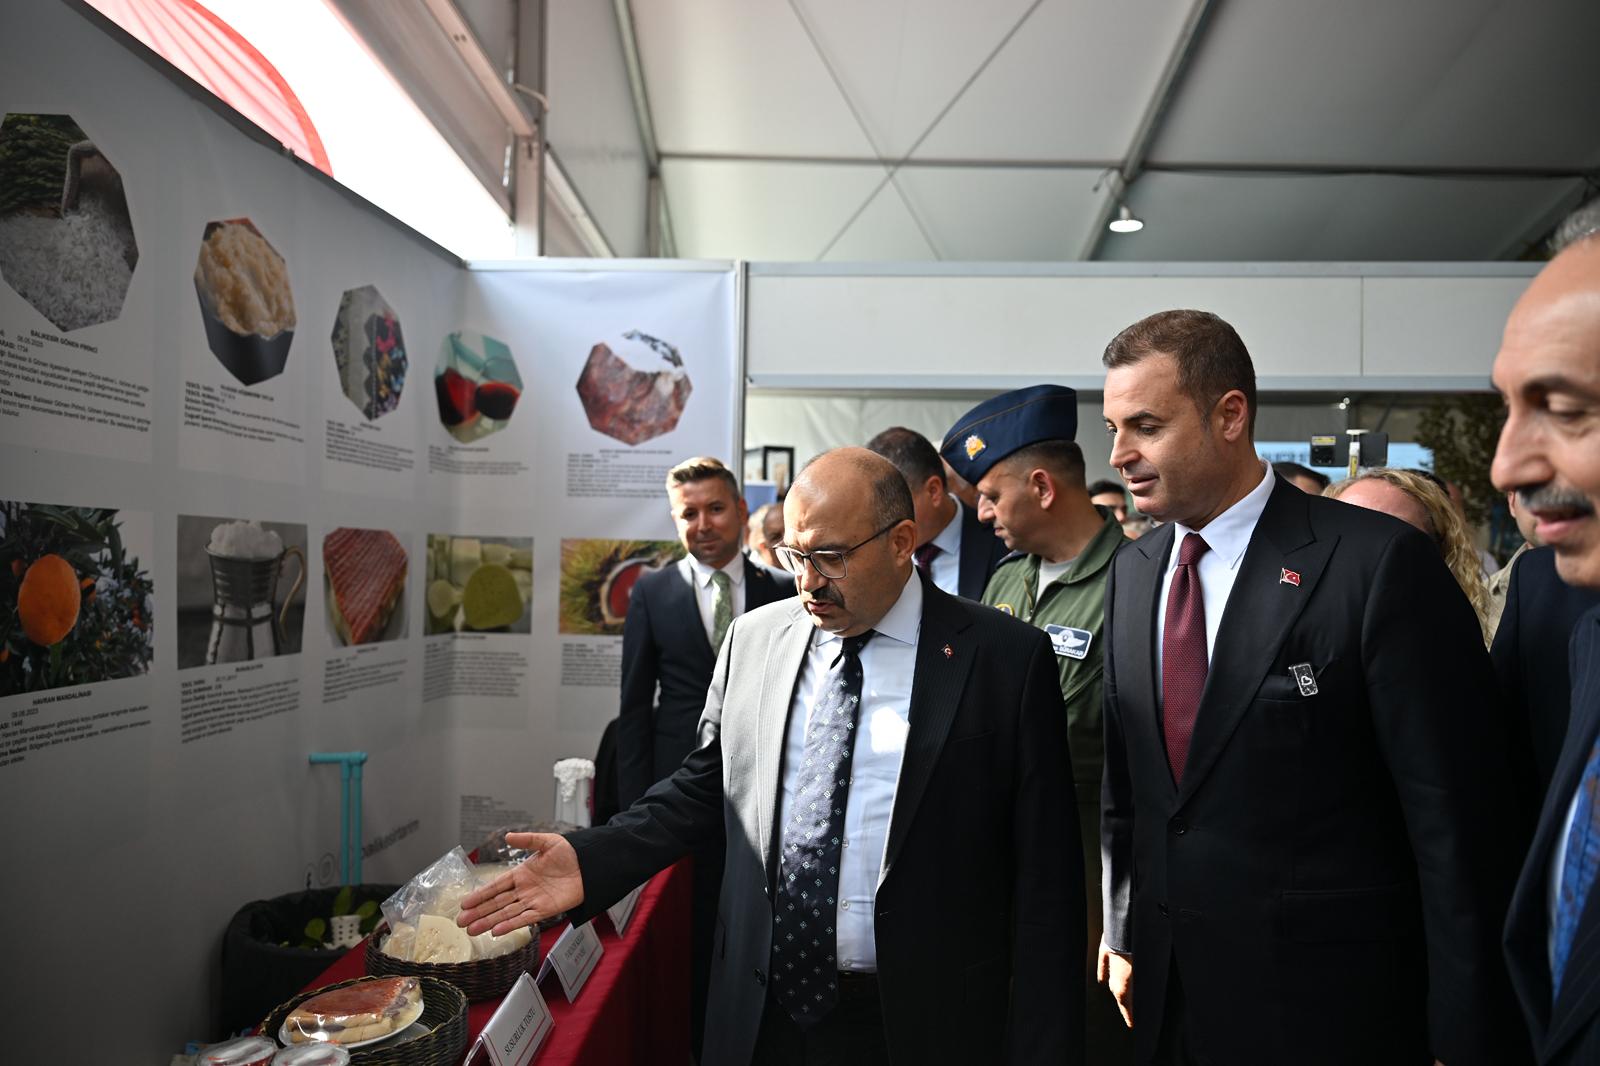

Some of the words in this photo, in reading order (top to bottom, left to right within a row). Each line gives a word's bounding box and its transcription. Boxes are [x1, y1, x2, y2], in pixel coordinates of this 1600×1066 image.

[60, 337, 79, 348] GÖNEN
[32, 695, 54, 705] HAVRAN
[504, 1024, 526, 1056] SUSURLUK
